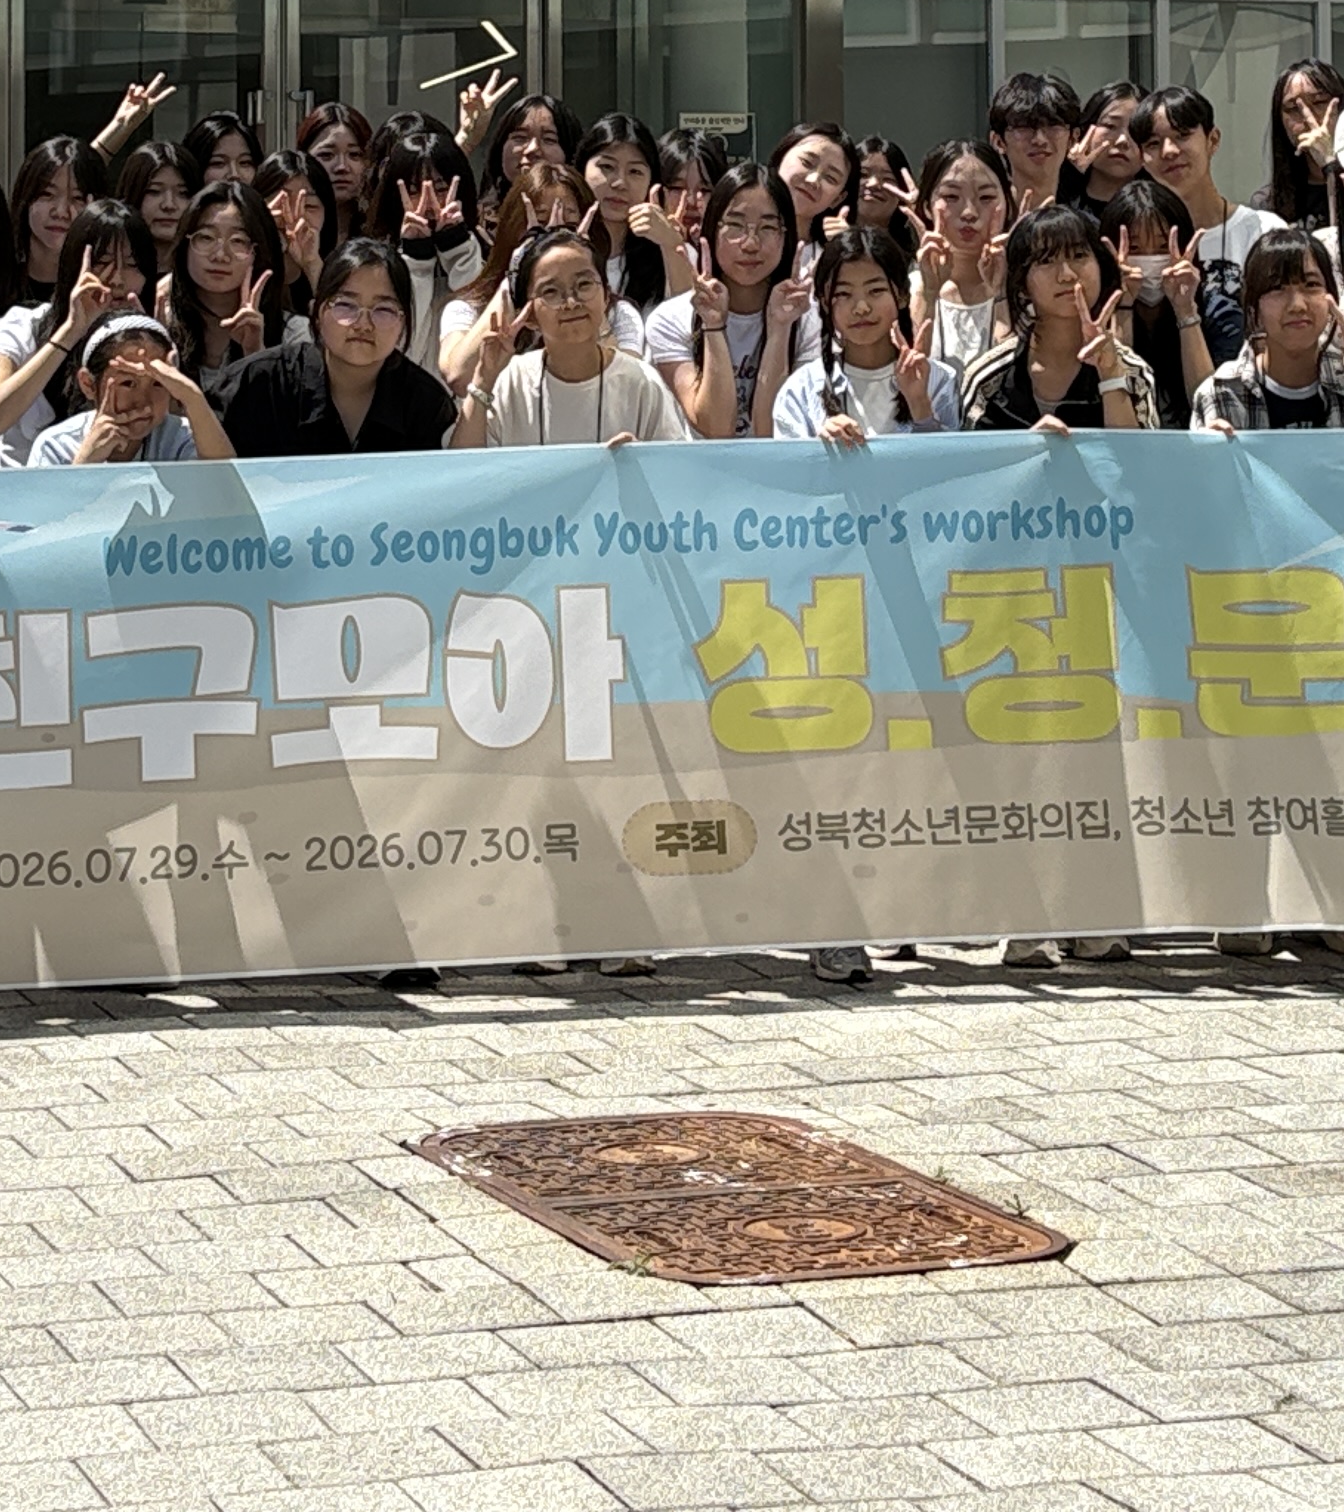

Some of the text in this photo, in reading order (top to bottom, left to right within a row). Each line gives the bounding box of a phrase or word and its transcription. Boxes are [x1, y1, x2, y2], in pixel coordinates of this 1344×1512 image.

[104, 496, 1135, 578] Welcome to Seongbuk Youth Center's workshop
[654, 819, 729, 858] 주최
[776, 798, 1123, 852] 성북청소년문화의집,
[1130, 795, 1235, 838] 청소년
